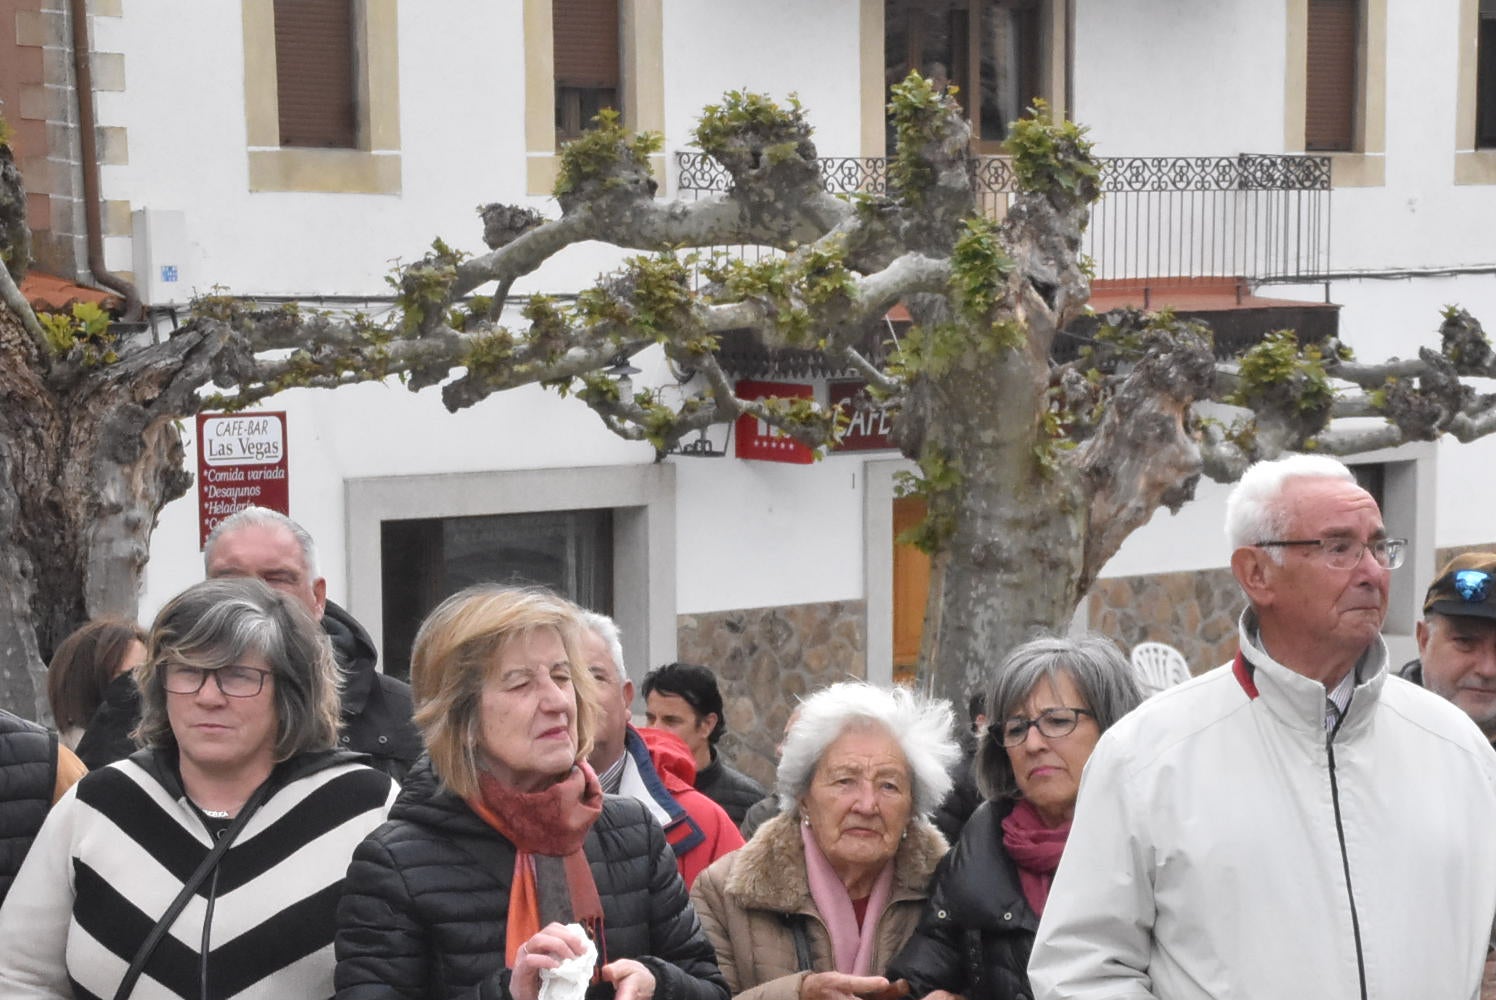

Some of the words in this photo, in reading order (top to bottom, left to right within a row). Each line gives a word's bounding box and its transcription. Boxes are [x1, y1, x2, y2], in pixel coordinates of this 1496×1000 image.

[215, 420, 269, 437] CAFE-BAR
[208, 439, 234, 456] Las
[238, 438, 279, 460] Vegas
[247, 466, 285, 481] variada
